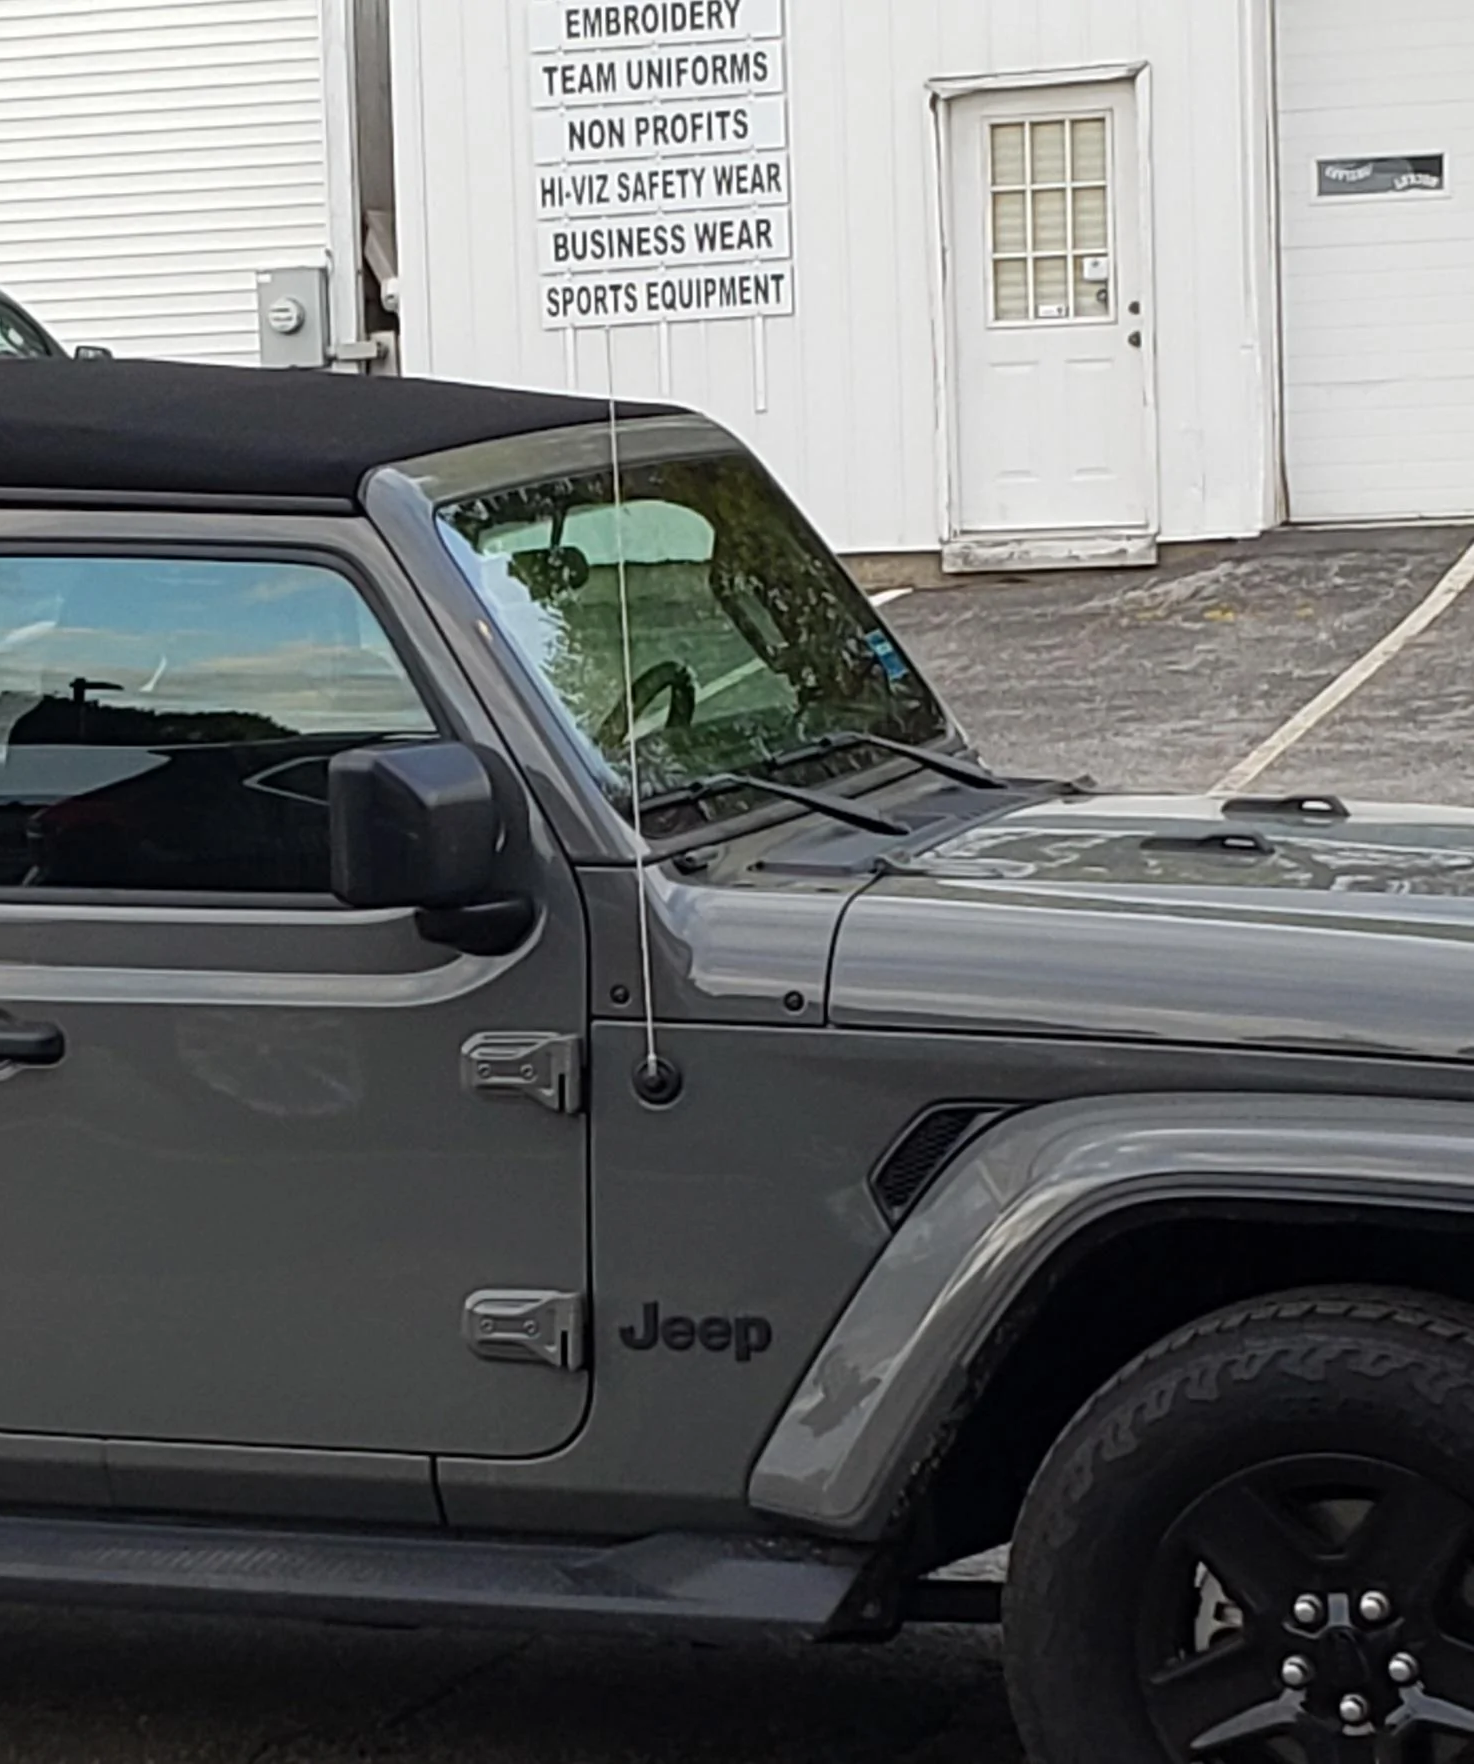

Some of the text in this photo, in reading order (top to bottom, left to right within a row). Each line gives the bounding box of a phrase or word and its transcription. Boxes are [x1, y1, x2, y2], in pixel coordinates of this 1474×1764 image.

[566, 0, 741, 38] EMBROIDERY
[542, 51, 769, 96] TEAM UNIFORMS
[568, 109, 749, 151] NON PROFITS
[617, 167, 706, 202] SAFETY
[713, 162, 782, 196] WEAR
[553, 219, 773, 262] BUSINESS WEAR
[547, 274, 785, 318] SPORTS EQUIPMENT
[618, 1301, 773, 1362] Jeep
